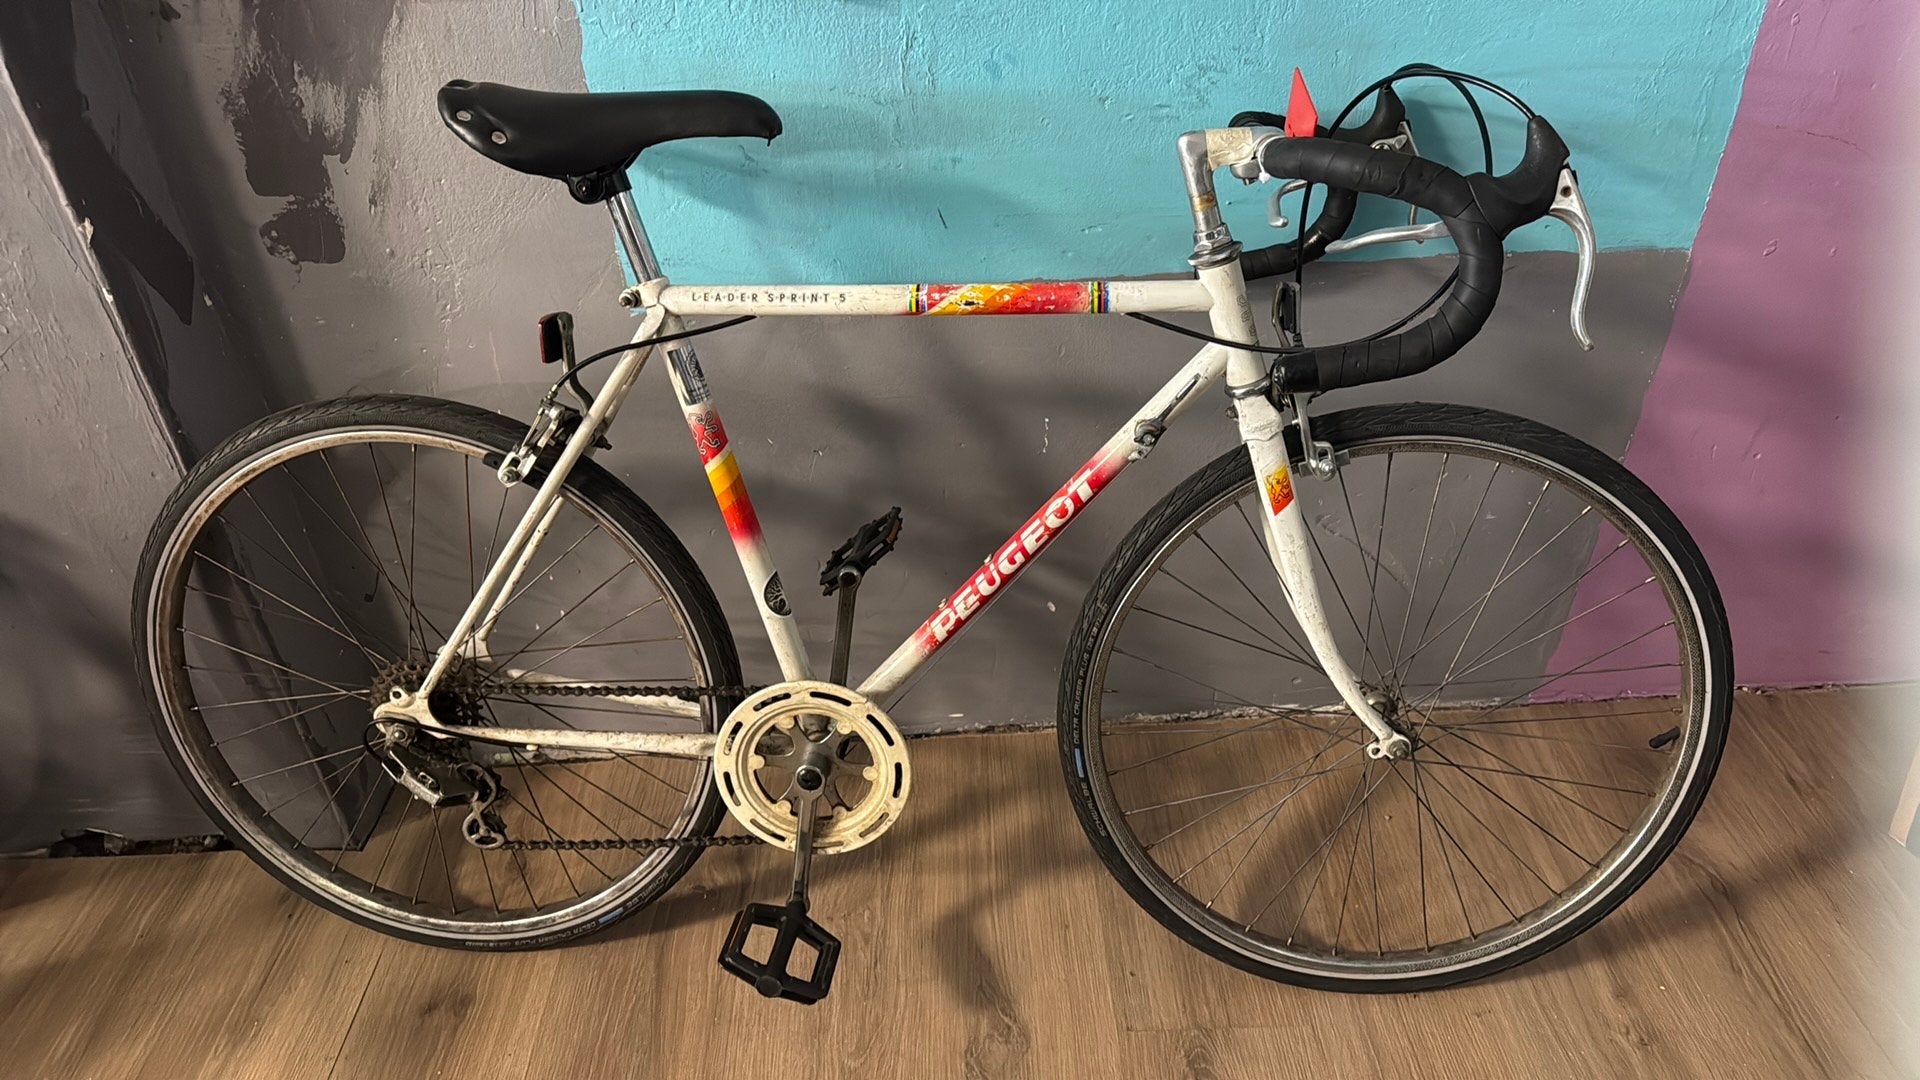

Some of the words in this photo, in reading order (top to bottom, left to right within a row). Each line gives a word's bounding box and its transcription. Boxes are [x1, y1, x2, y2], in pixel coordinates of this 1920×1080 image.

[839, 292, 846, 303] 5
[929, 468, 1093, 642] PEUGEOT
[1073, 679, 1084, 715] CRUISER
[1079, 652, 1090, 677] PLUS
[1081, 782, 1107, 837] SCHWALBE
